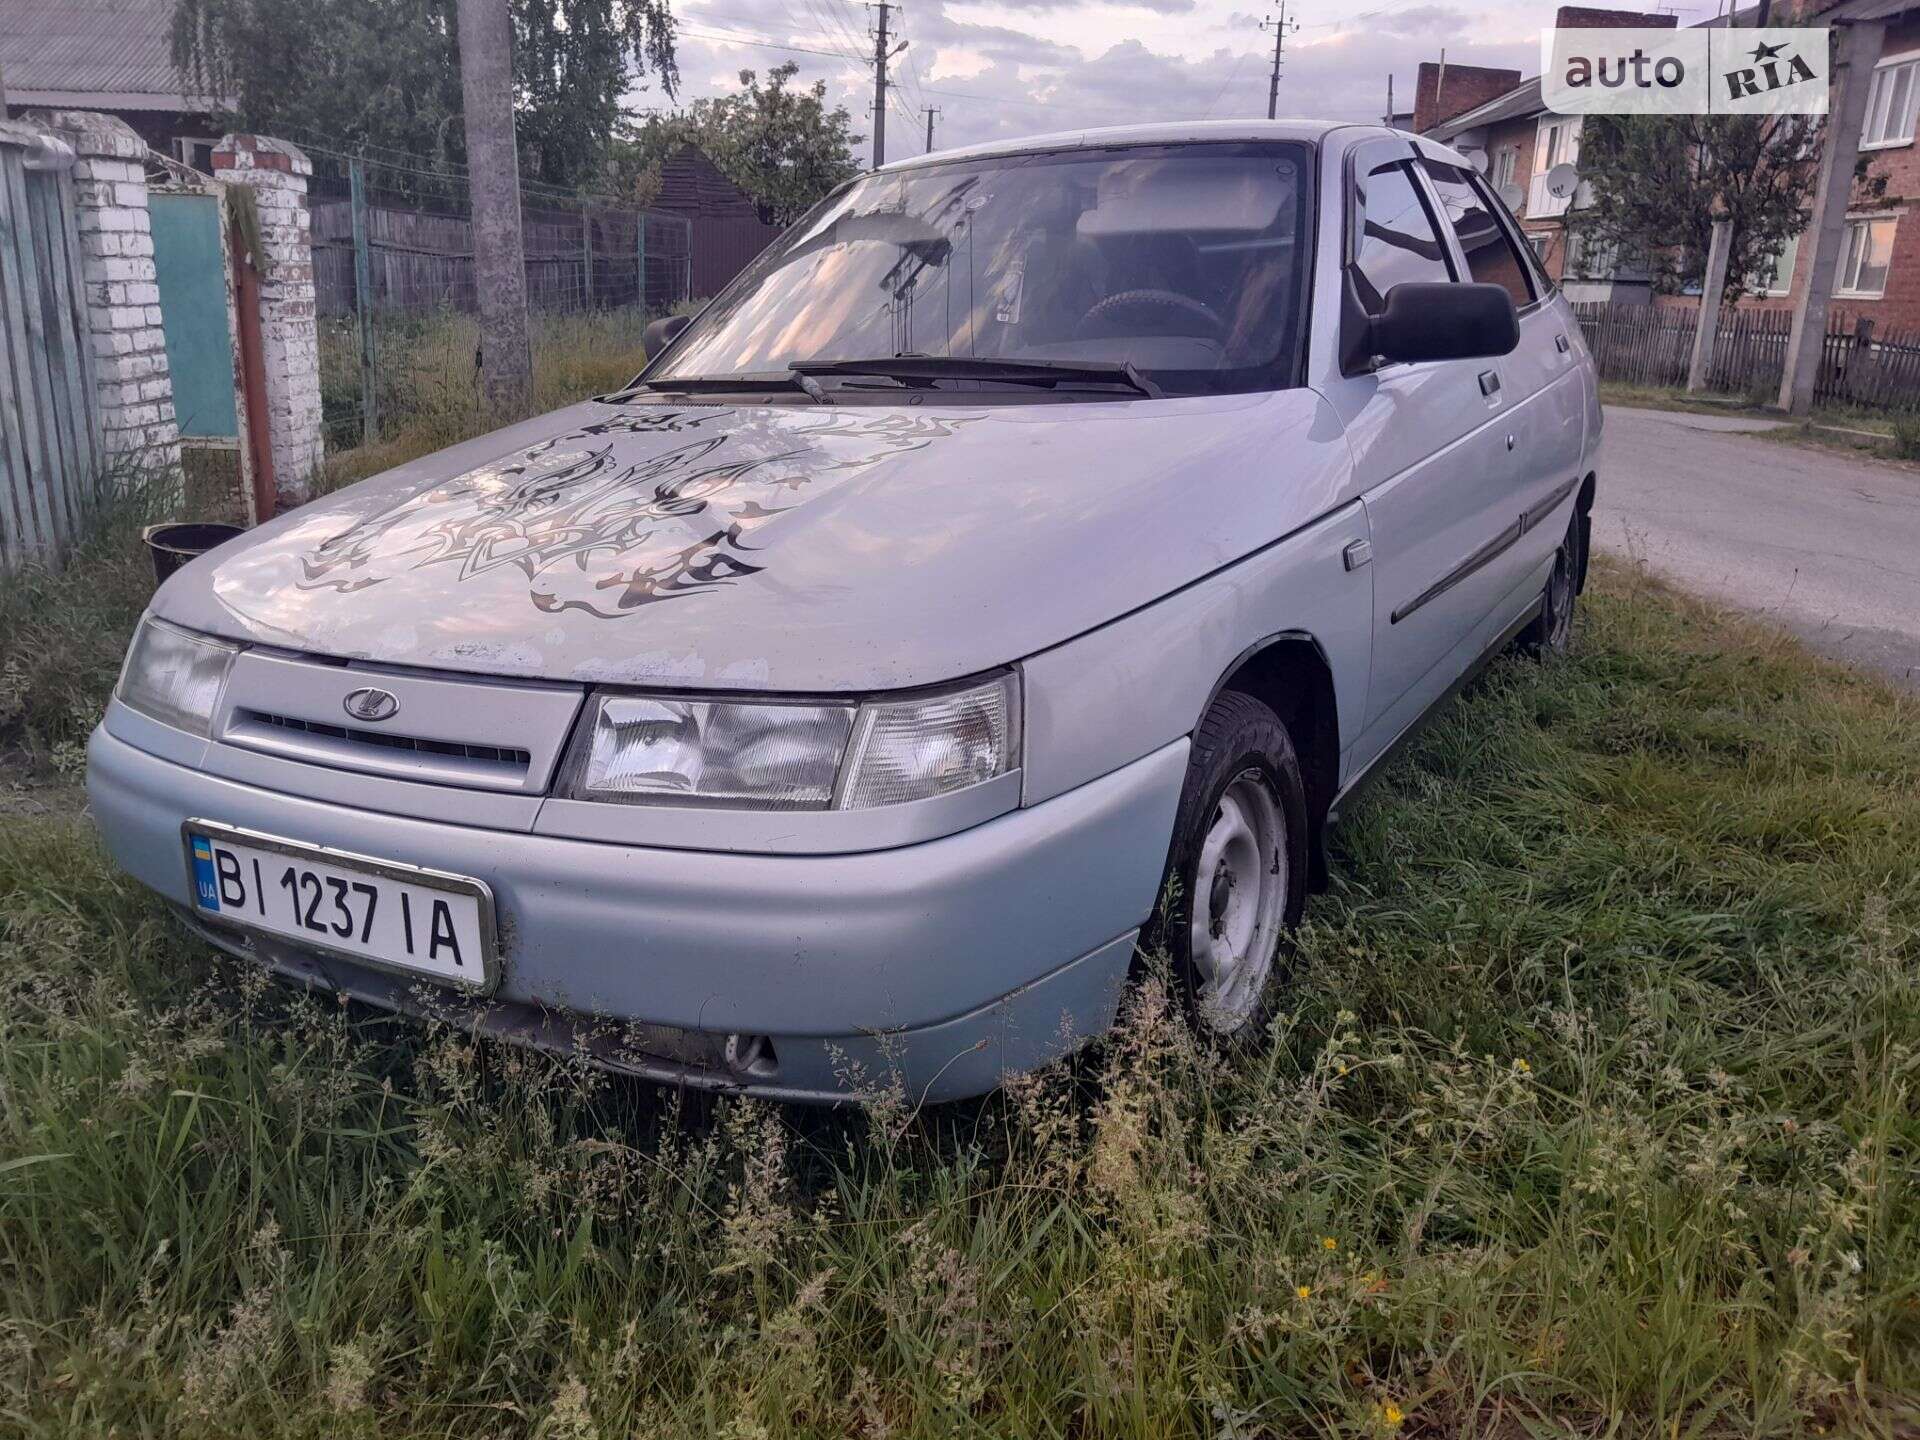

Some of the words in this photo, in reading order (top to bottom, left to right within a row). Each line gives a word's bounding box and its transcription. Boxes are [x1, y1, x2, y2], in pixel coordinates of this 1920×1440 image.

[199, 881, 216, 900] UA
[215, 848, 266, 916] BI
[280, 867, 378, 943] 1237
[401, 892, 463, 966] IA
